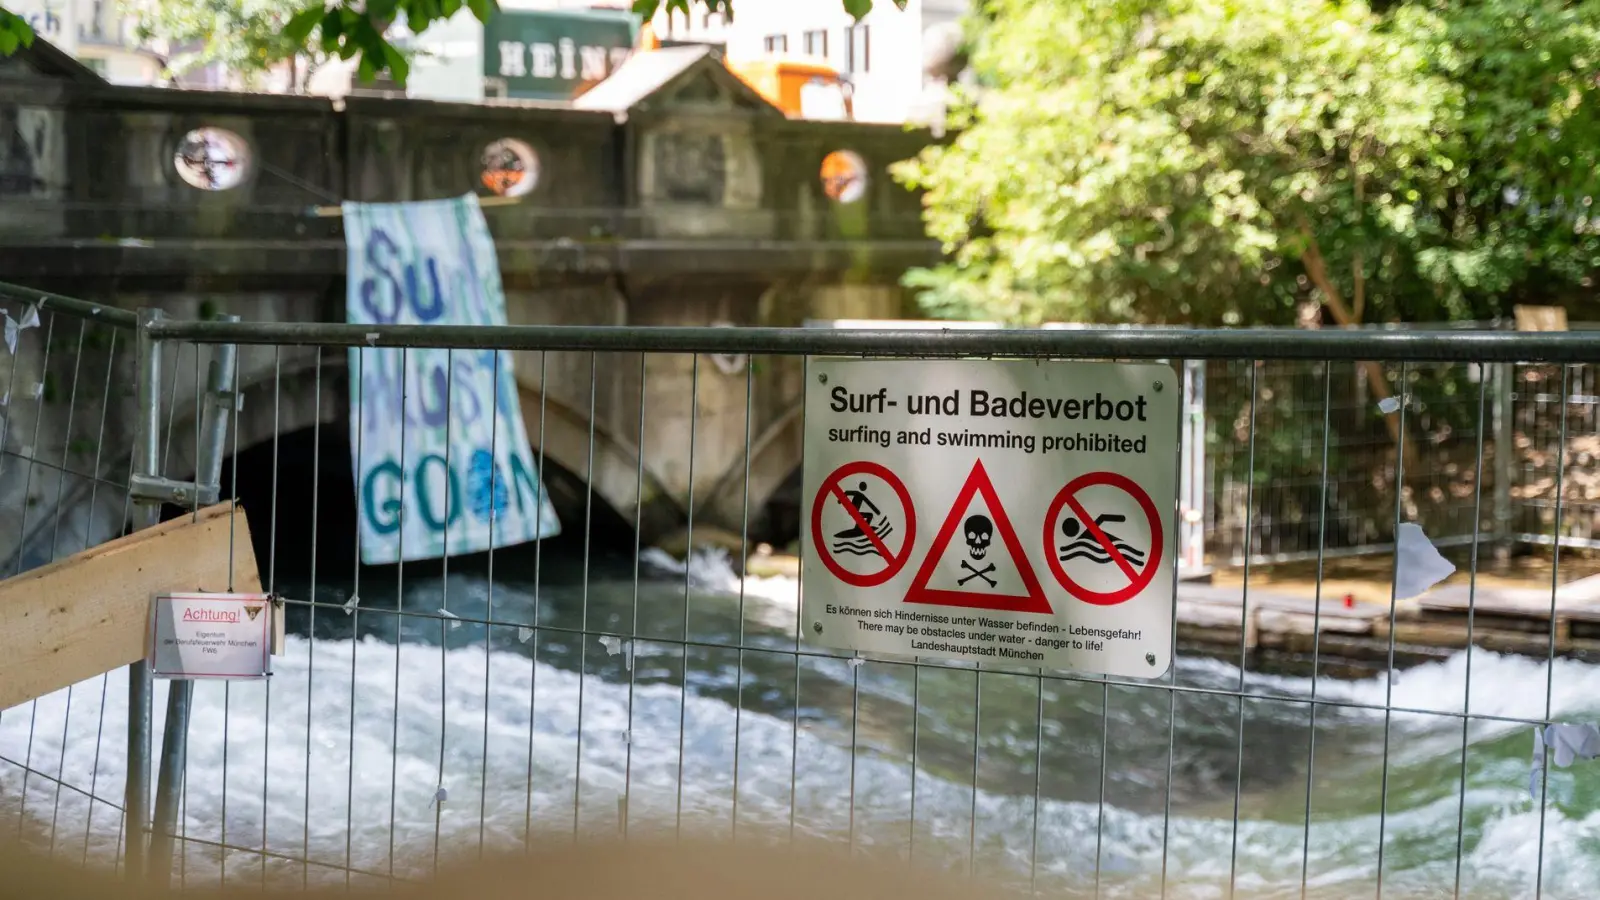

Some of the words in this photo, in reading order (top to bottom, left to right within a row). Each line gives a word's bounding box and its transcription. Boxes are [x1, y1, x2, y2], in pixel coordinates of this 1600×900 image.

[830, 385, 897, 413] Surf-
[907, 389, 960, 416] und
[970, 389, 1147, 422] Badeverbot
[828, 425, 891, 448] surfing
[896, 428, 931, 445] and
[937, 429, 1036, 453] swimming
[1042, 432, 1147, 454] prohibited
[183, 606, 241, 624] Achtung!
[826, 604, 837, 614] Es
[839, 606, 872, 618] können
[874, 609, 893, 620] sich
[895, 611, 949, 624] Hindernisse
[951, 616, 977, 627] unter
[978, 617, 1014, 630] Wasser
[1016, 620, 1059, 634] befinden
[1069, 625, 1142, 641] Lebensgefahr!
[196, 631, 225, 639] Eigentum
[228, 640, 257, 648] München
[857, 620, 883, 632] There
[885, 624, 905, 636] may
[906, 624, 919, 635] be
[920, 626, 966, 640] obstacles
[968, 631, 996, 642] under
[998, 634, 1026, 645] water
[1034, 636, 1069, 650] danger
[1072, 640, 1083, 650] to
[1085, 640, 1104, 652] life!
[911, 639, 996, 657] Landeshauptstadt
[998, 648, 1045, 661] München
